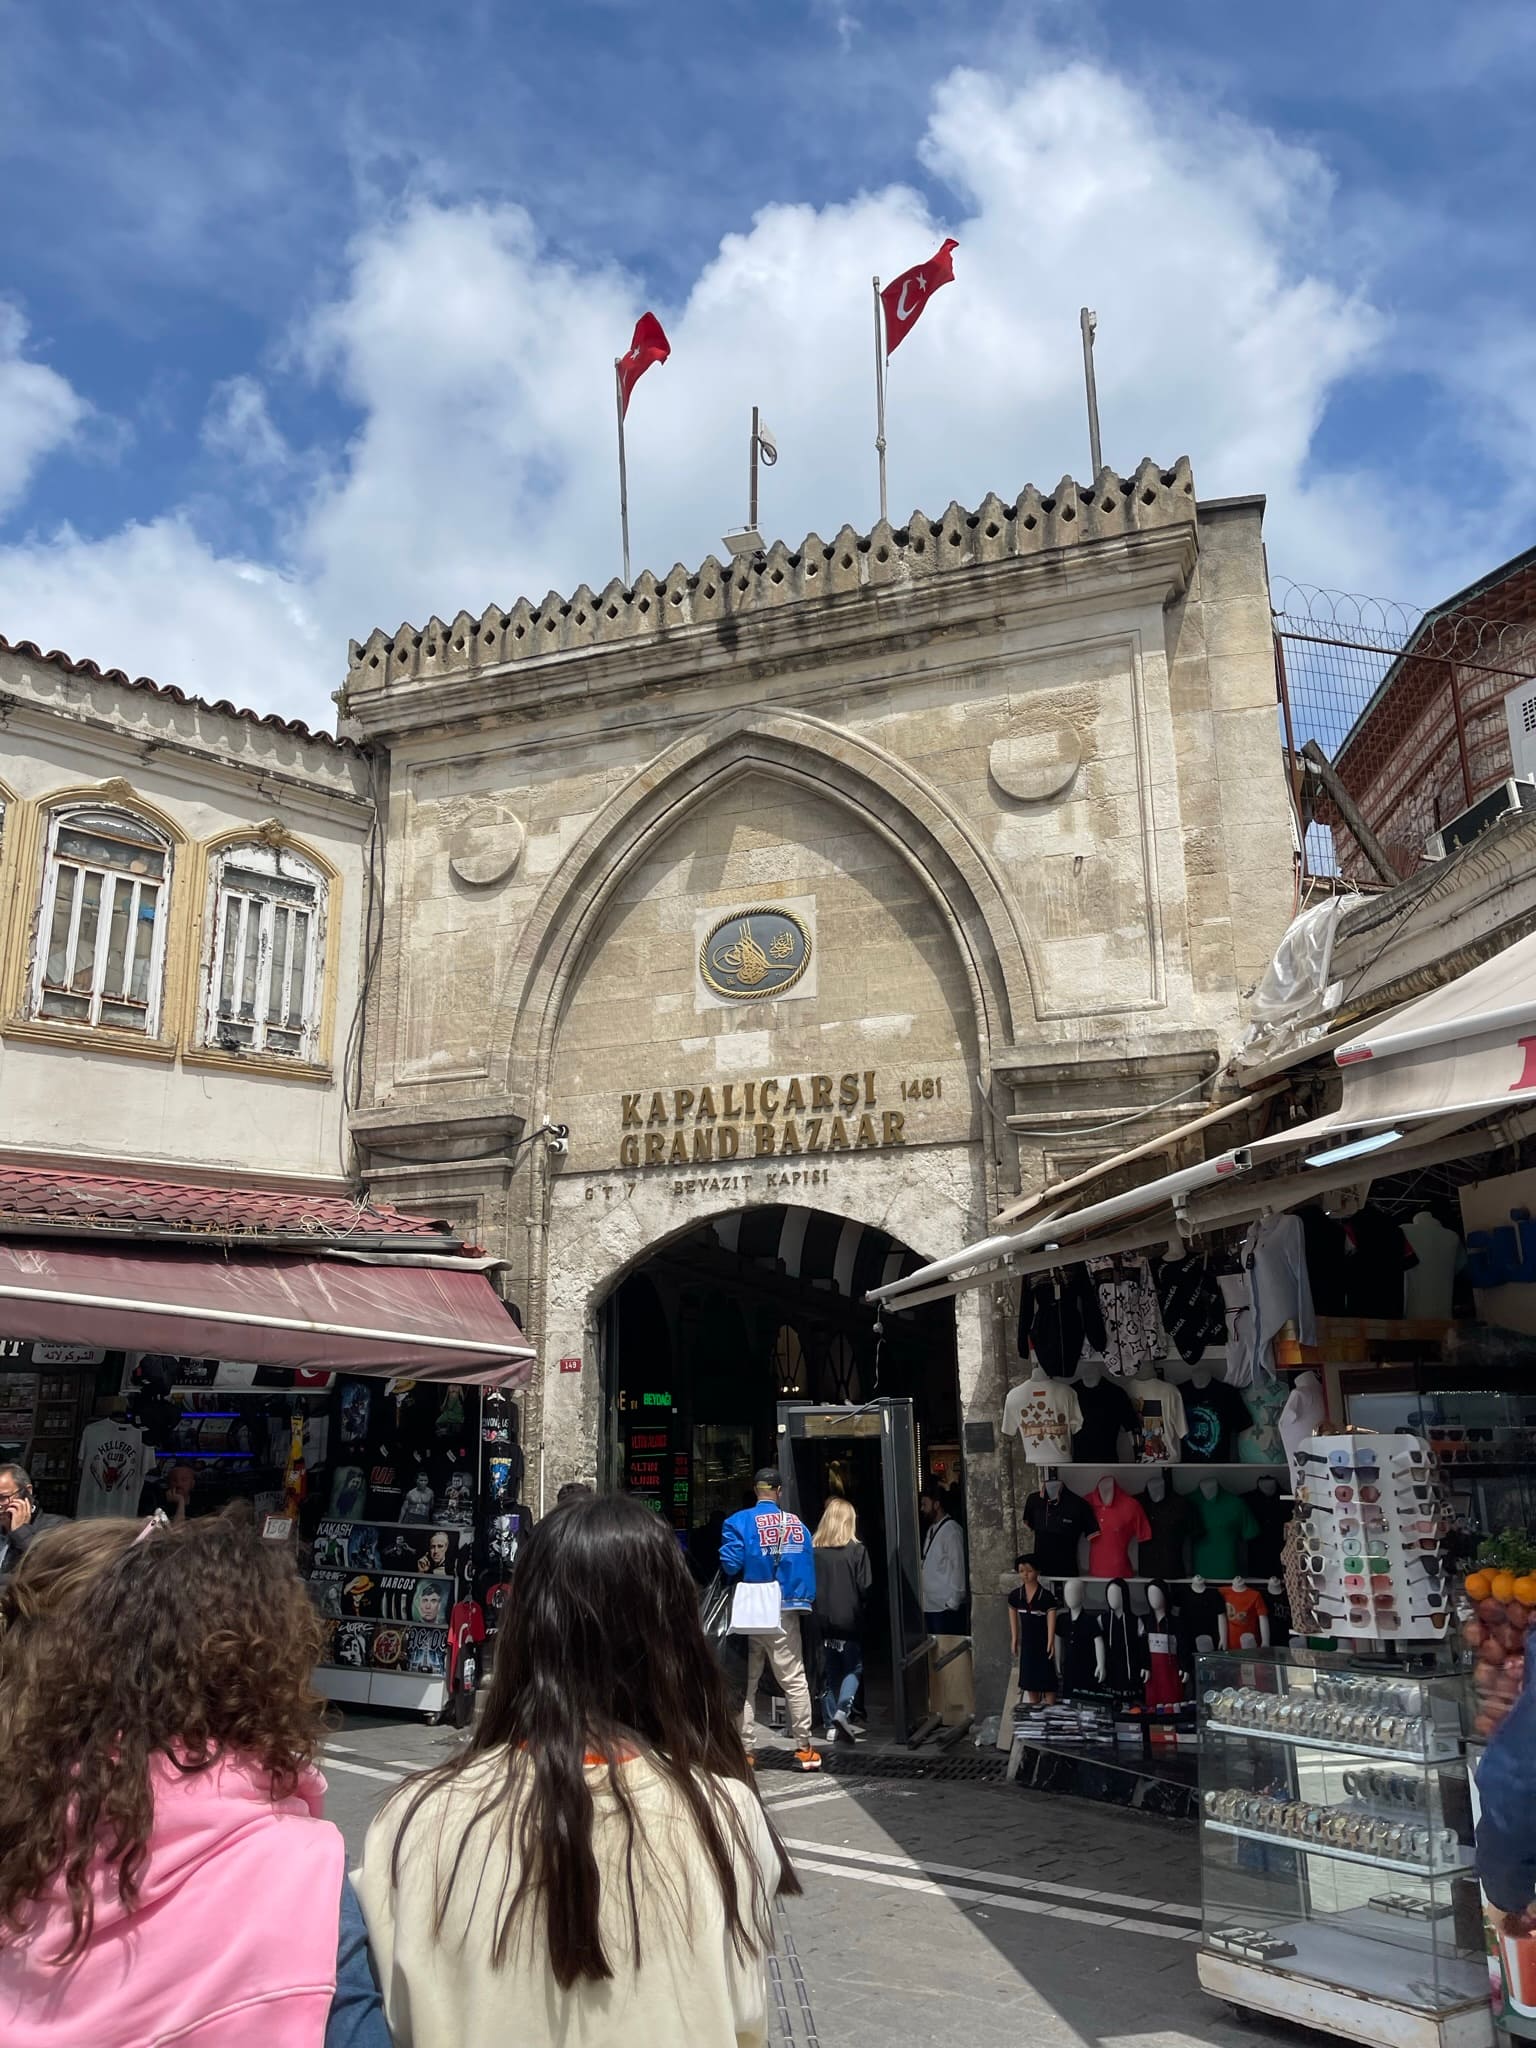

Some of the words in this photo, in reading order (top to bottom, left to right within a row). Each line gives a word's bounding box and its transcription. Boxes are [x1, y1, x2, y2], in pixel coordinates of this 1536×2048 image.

[621, 1071, 877, 1126] KAPALIÇARŞI
[900, 1077, 942, 1102] 1461
[620, 1126, 739, 1166] GRAND
[754, 1111, 905, 1155] BAZAAR
[585, 1187, 594, 1200] G
[603, 1186, 613, 1200] T
[674, 1175, 752, 1196] BEYAZIT
[766, 1169, 829, 1187] KAPISI
[565, 1361, 577, 1369] 149
[98, 1440, 136, 1457] HELLFIRE
[107, 1452, 124, 1462] CLUB
[759, 1526, 804, 1547] 1975
[380, 1576, 416, 1591] NARCOS
